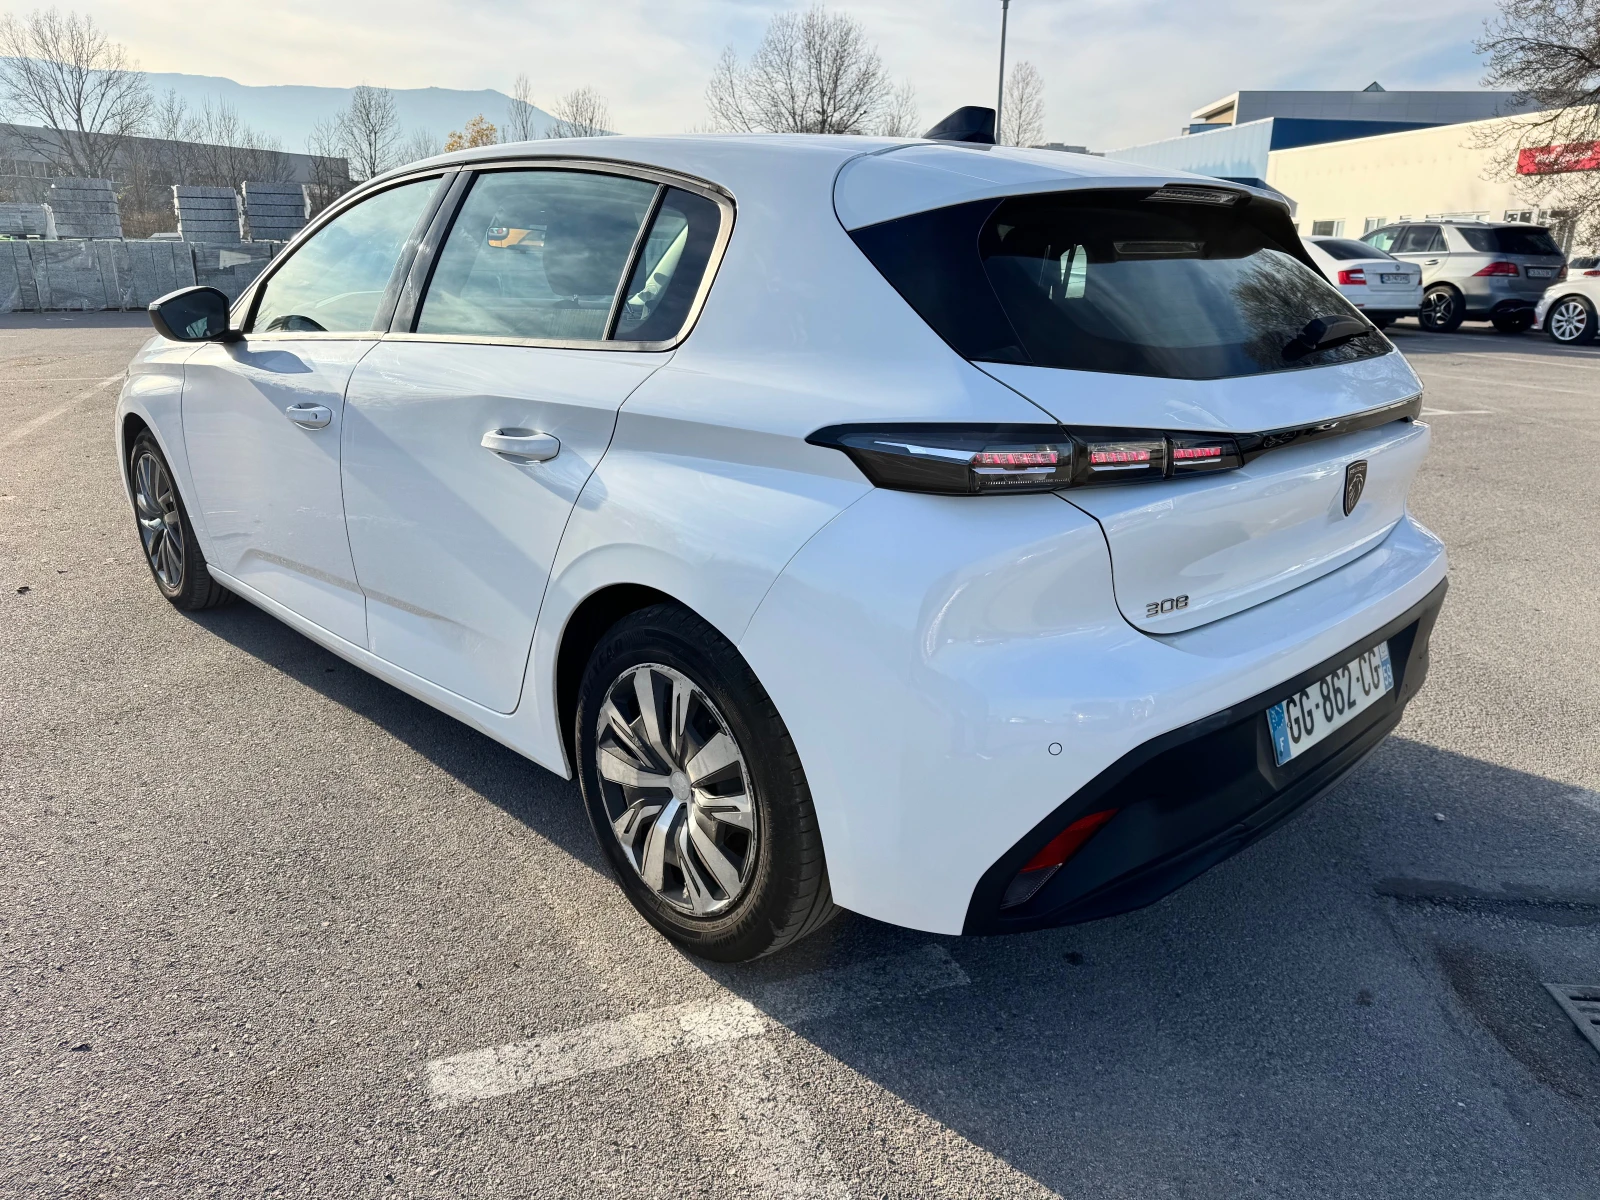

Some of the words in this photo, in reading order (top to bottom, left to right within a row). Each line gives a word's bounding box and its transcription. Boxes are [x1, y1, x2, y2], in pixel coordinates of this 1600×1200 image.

[1146, 594, 1189, 618] 308
[1382, 665, 1393, 685] 59
[1286, 649, 1380, 744] GG-862-CG
[1279, 736, 1286, 752] F
